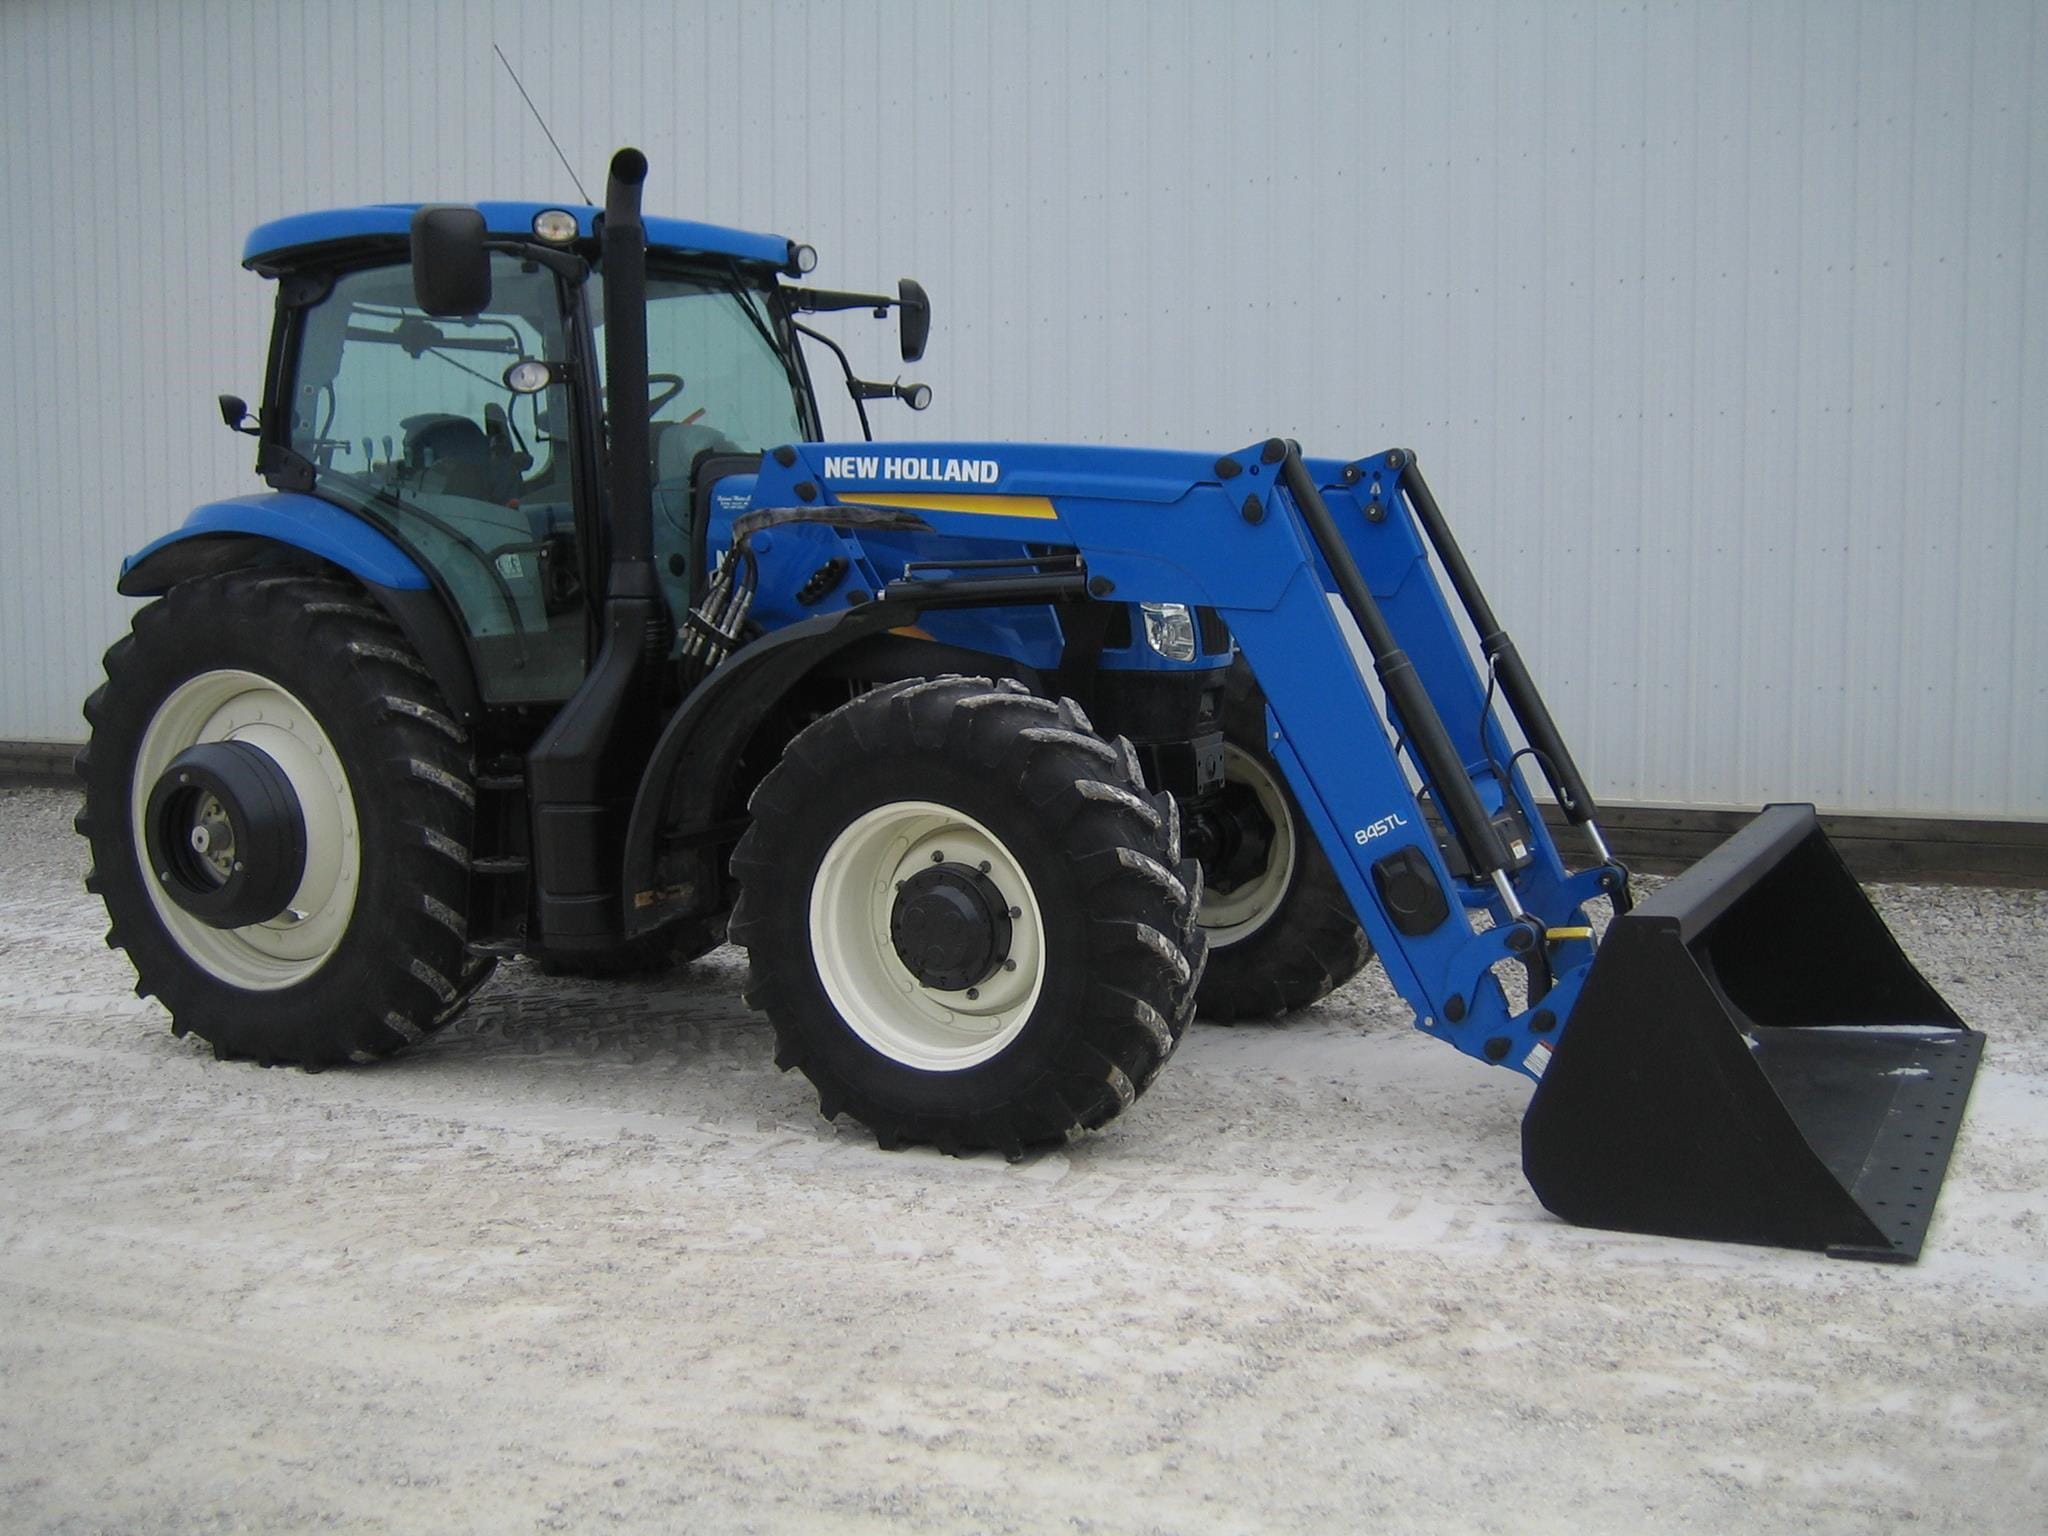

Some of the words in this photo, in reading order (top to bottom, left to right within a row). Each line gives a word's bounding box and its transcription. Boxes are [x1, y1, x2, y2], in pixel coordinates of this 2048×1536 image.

[824, 456, 879, 479] NEW
[884, 457, 999, 483] HOLLAND
[1354, 813, 1408, 845] 845TL
